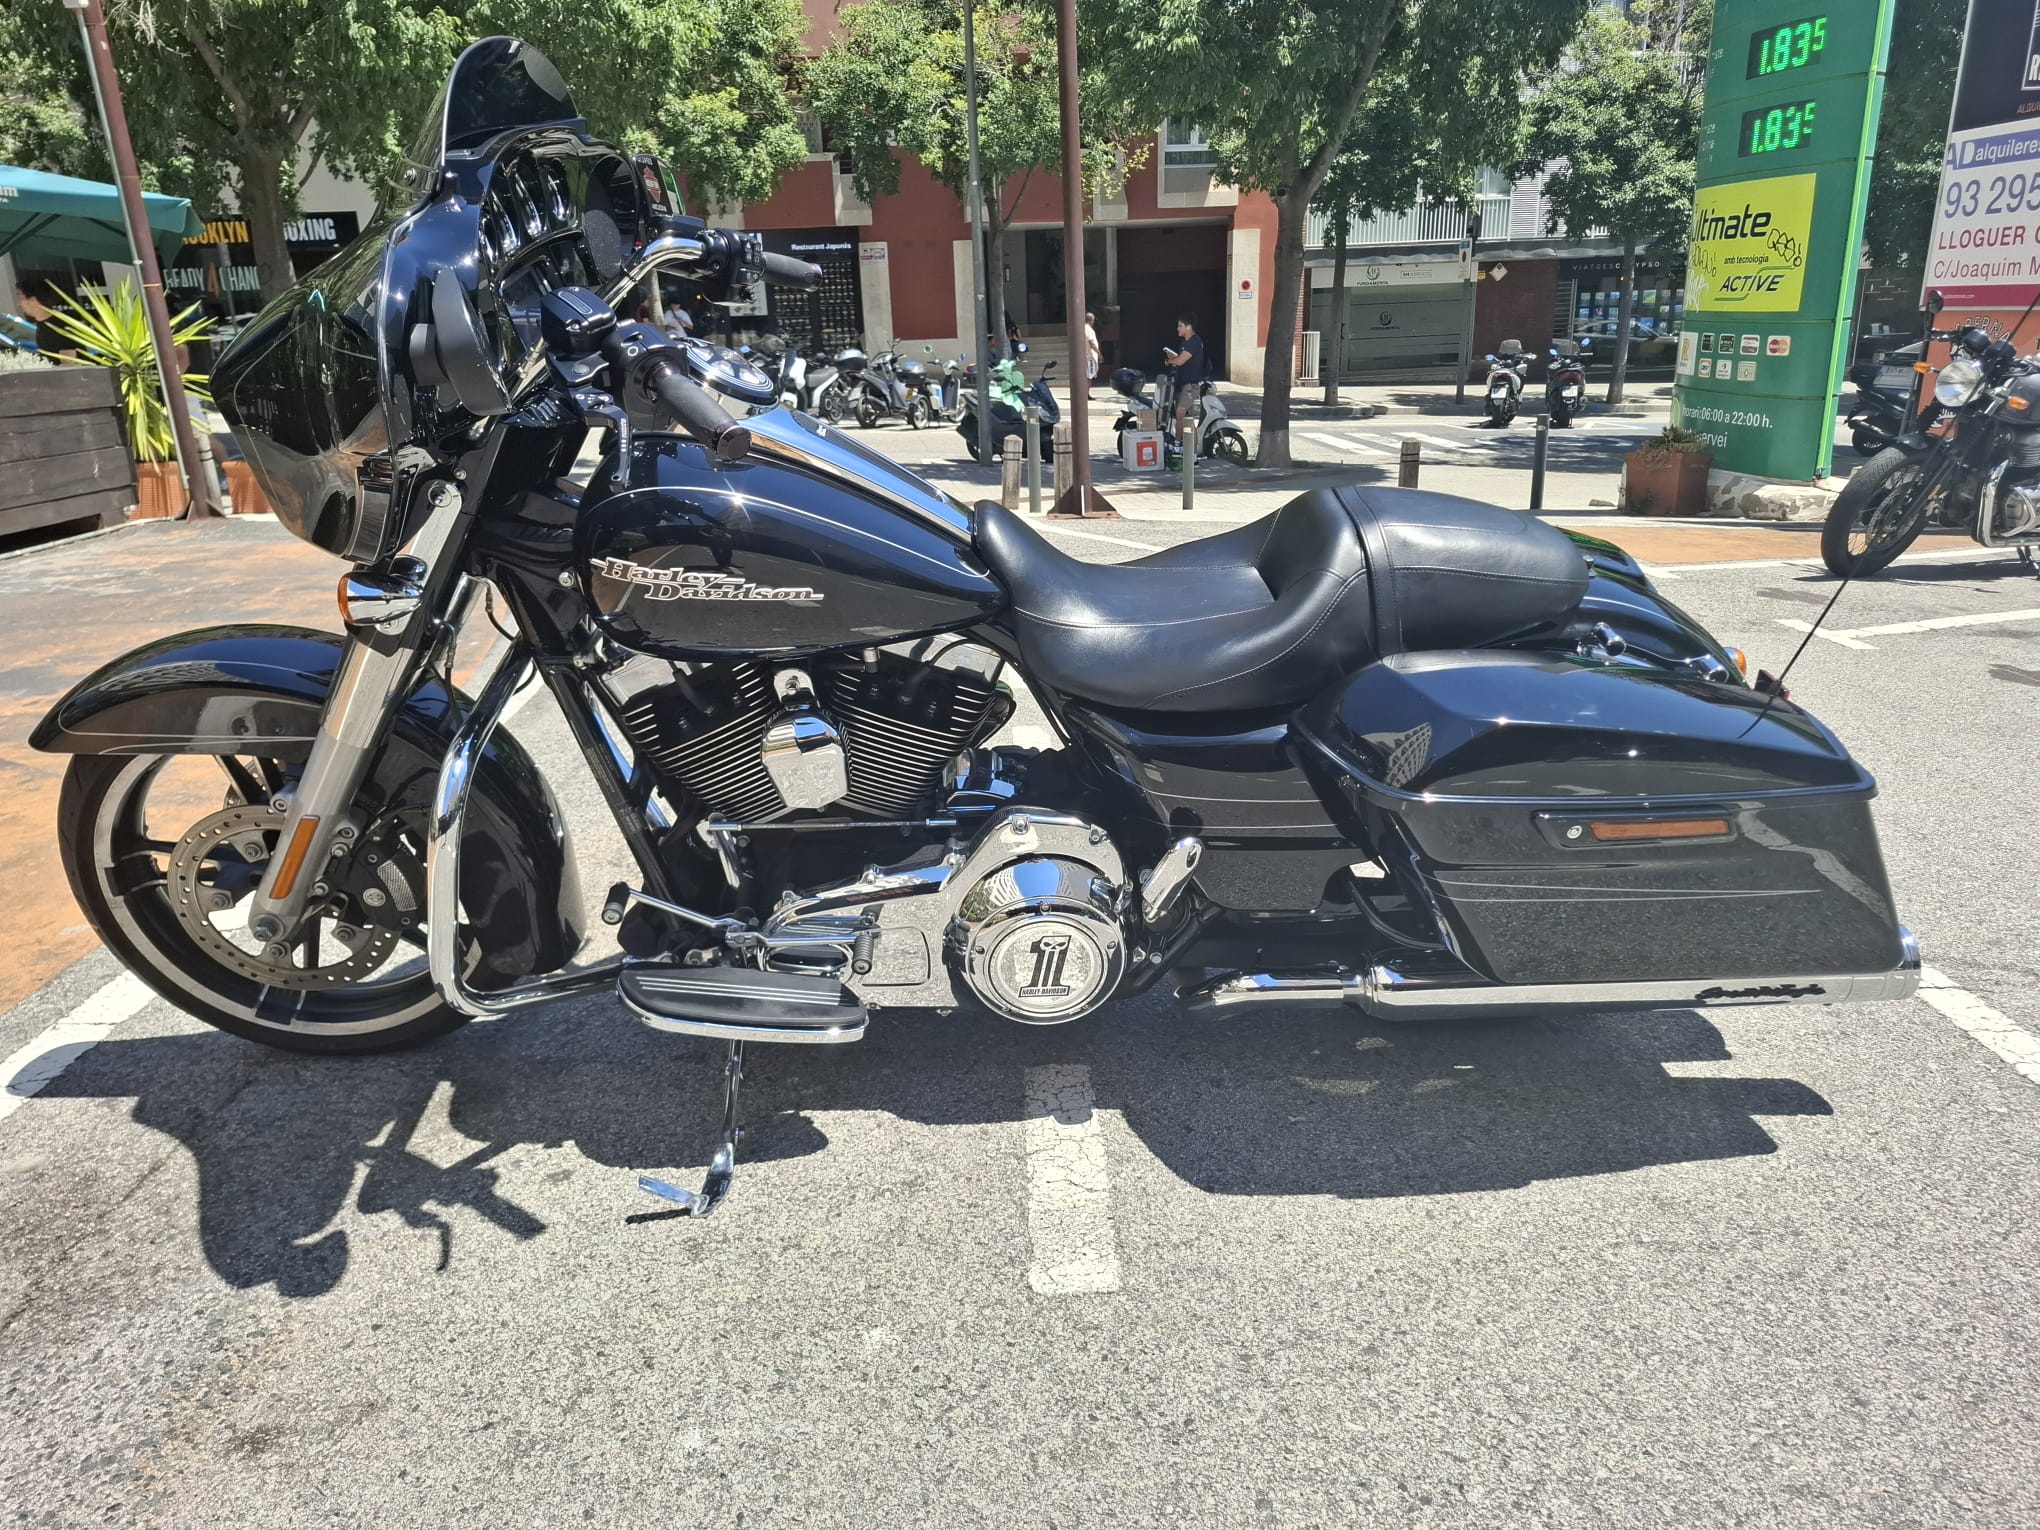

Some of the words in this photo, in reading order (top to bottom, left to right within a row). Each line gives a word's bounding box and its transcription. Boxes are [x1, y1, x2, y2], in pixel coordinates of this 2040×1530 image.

[1944, 179, 1981, 219] 93
[1938, 225, 2026, 250] LLOGUER
[1724, 255, 1735, 265] amb
[1934, 257, 2022, 281] C/Joaquim
[1719, 274, 1785, 292] ACTIVE
[1724, 413, 1730, 423] a
[1731, 411, 1760, 427] 22:00
[590, 556, 743, 589] Harley
[645, 582, 824, 601] Davidson
